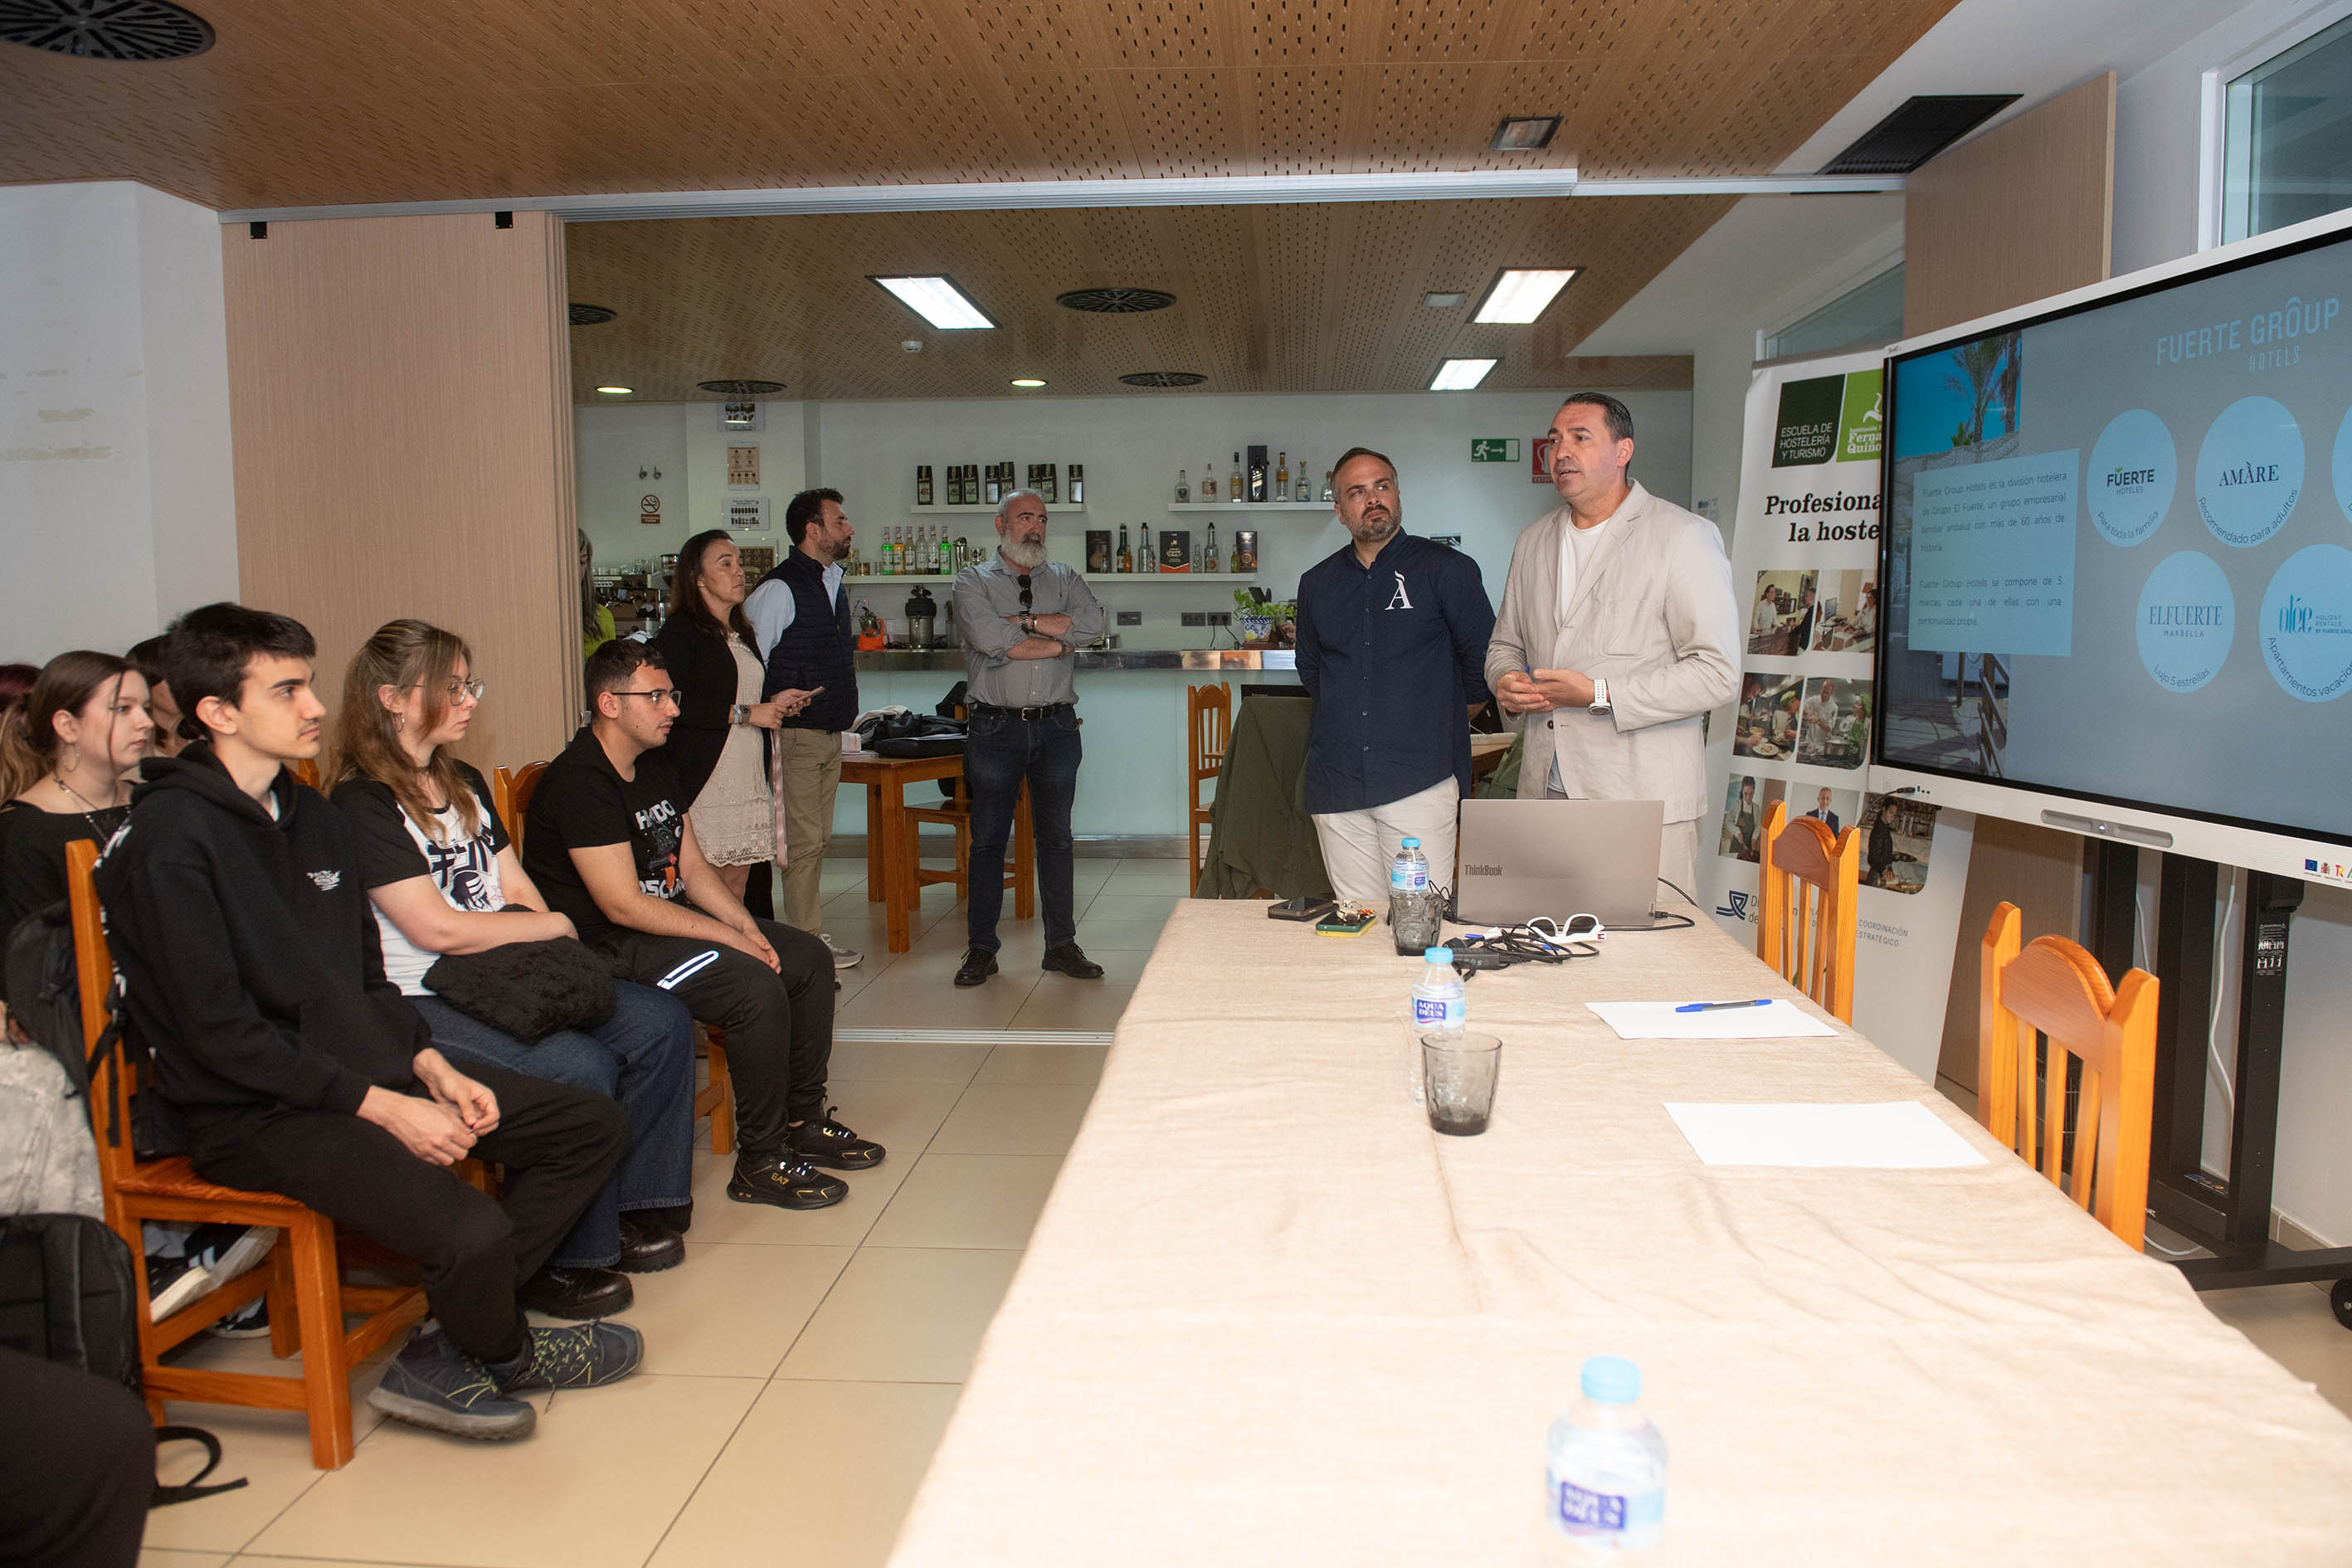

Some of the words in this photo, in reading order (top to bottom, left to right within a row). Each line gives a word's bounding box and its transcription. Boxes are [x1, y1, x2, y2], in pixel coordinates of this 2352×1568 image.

[2156, 319, 2242, 365] FUERTE
[2249, 345, 2300, 373] HOTELS
[1780, 424, 1819, 437] ESCUELA
[1820, 422, 1833, 432] DE
[1780, 433, 1831, 448] HOSTELERÍA
[1781, 450, 1788, 460] Y
[1790, 447, 1827, 460] TURISMO
[1966, 481, 1986, 492] Hotels
[2037, 471, 2067, 485] hotelera
[2106, 469, 2155, 488] FUERTE
[2218, 460, 2280, 487] AMÀRE
[2116, 486, 2144, 496] HOTELES
[1765, 491, 1881, 515] Profesiona
[1954, 504, 1960, 513] El
[1989, 501, 1997, 509] un
[2000, 498, 2021, 511] grupo
[2023, 492, 2067, 506] empresarial
[1975, 521, 1987, 529] con
[2008, 517, 2018, 527] de
[2021, 515, 2030, 526] 60
[2055, 513, 2065, 523] de
[2097, 511, 2111, 531] Para
[2111, 528, 2126, 539] toda
[2128, 530, 2135, 538] la
[2135, 510, 2159, 537] familia
[2199, 497, 2248, 543] Recomendado
[2250, 526, 2271, 544] para
[2272, 488, 2298, 529] adultos
[1788, 523, 1810, 542] la
[1816, 519, 1880, 541] hoste
[1967, 577, 1987, 587] Hotels
[1991, 579, 1999, 587] se
[2004, 577, 2038, 588] compone
[2043, 577, 2053, 586] de
[1989, 597, 1996, 606] de
[2004, 597, 2018, 606] ellas
[2027, 598, 2039, 606] con
[2048, 598, 2062, 606] una
[2164, 630, 2204, 638] MARBELLA
[2154, 664, 2170, 684] Lujo
[2170, 675, 2176, 686] 5
[2176, 668, 2210, 687] estrellas
[2268, 636, 2317, 697] Apartamentos
[1464, 864, 1503, 877] ThinkBook
[1858, 918, 1909, 937] COORDINACIÓN
[1419, 1001, 1444, 1010] AQUA
[771, 1172, 790, 1186] EA7
